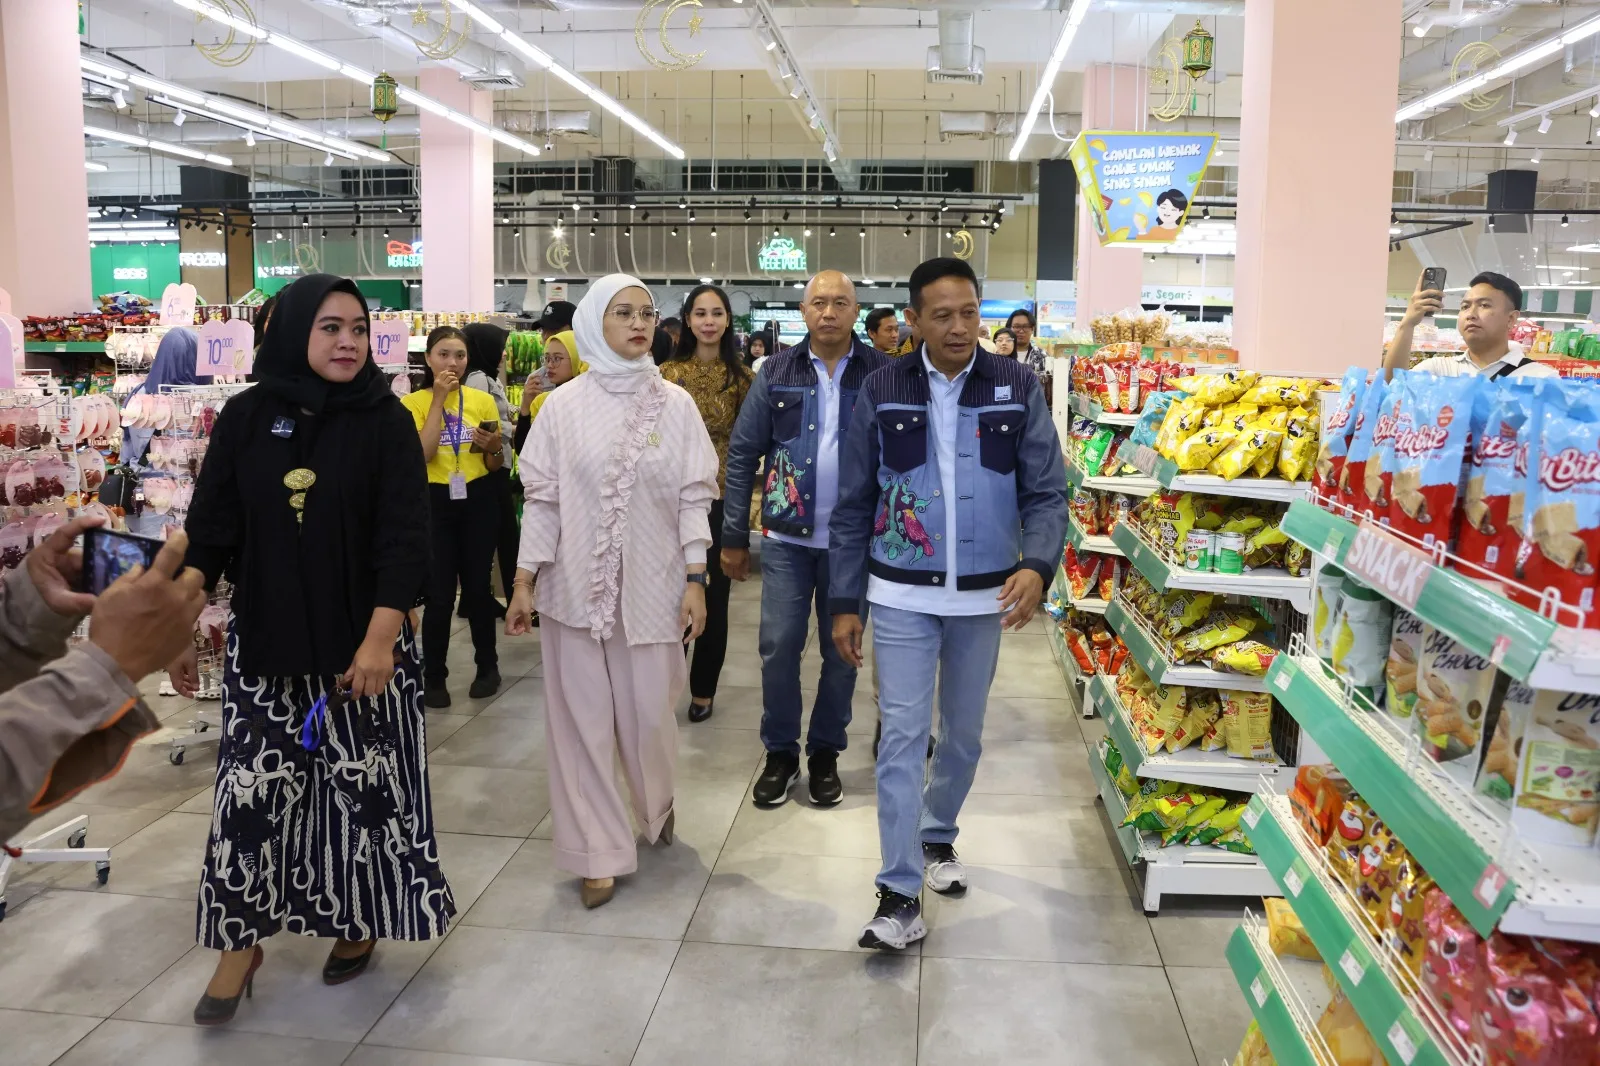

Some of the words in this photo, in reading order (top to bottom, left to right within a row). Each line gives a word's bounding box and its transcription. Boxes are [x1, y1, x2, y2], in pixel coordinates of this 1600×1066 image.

[1159, 144, 1201, 158] WENAK
[1103, 163, 1137, 176] GAWE
[1139, 160, 1175, 173] UMAK
[179, 252, 226, 267] FROZEN
[1156, 289, 1187, 301] Segar
[1347, 527, 1426, 604] SNACK
